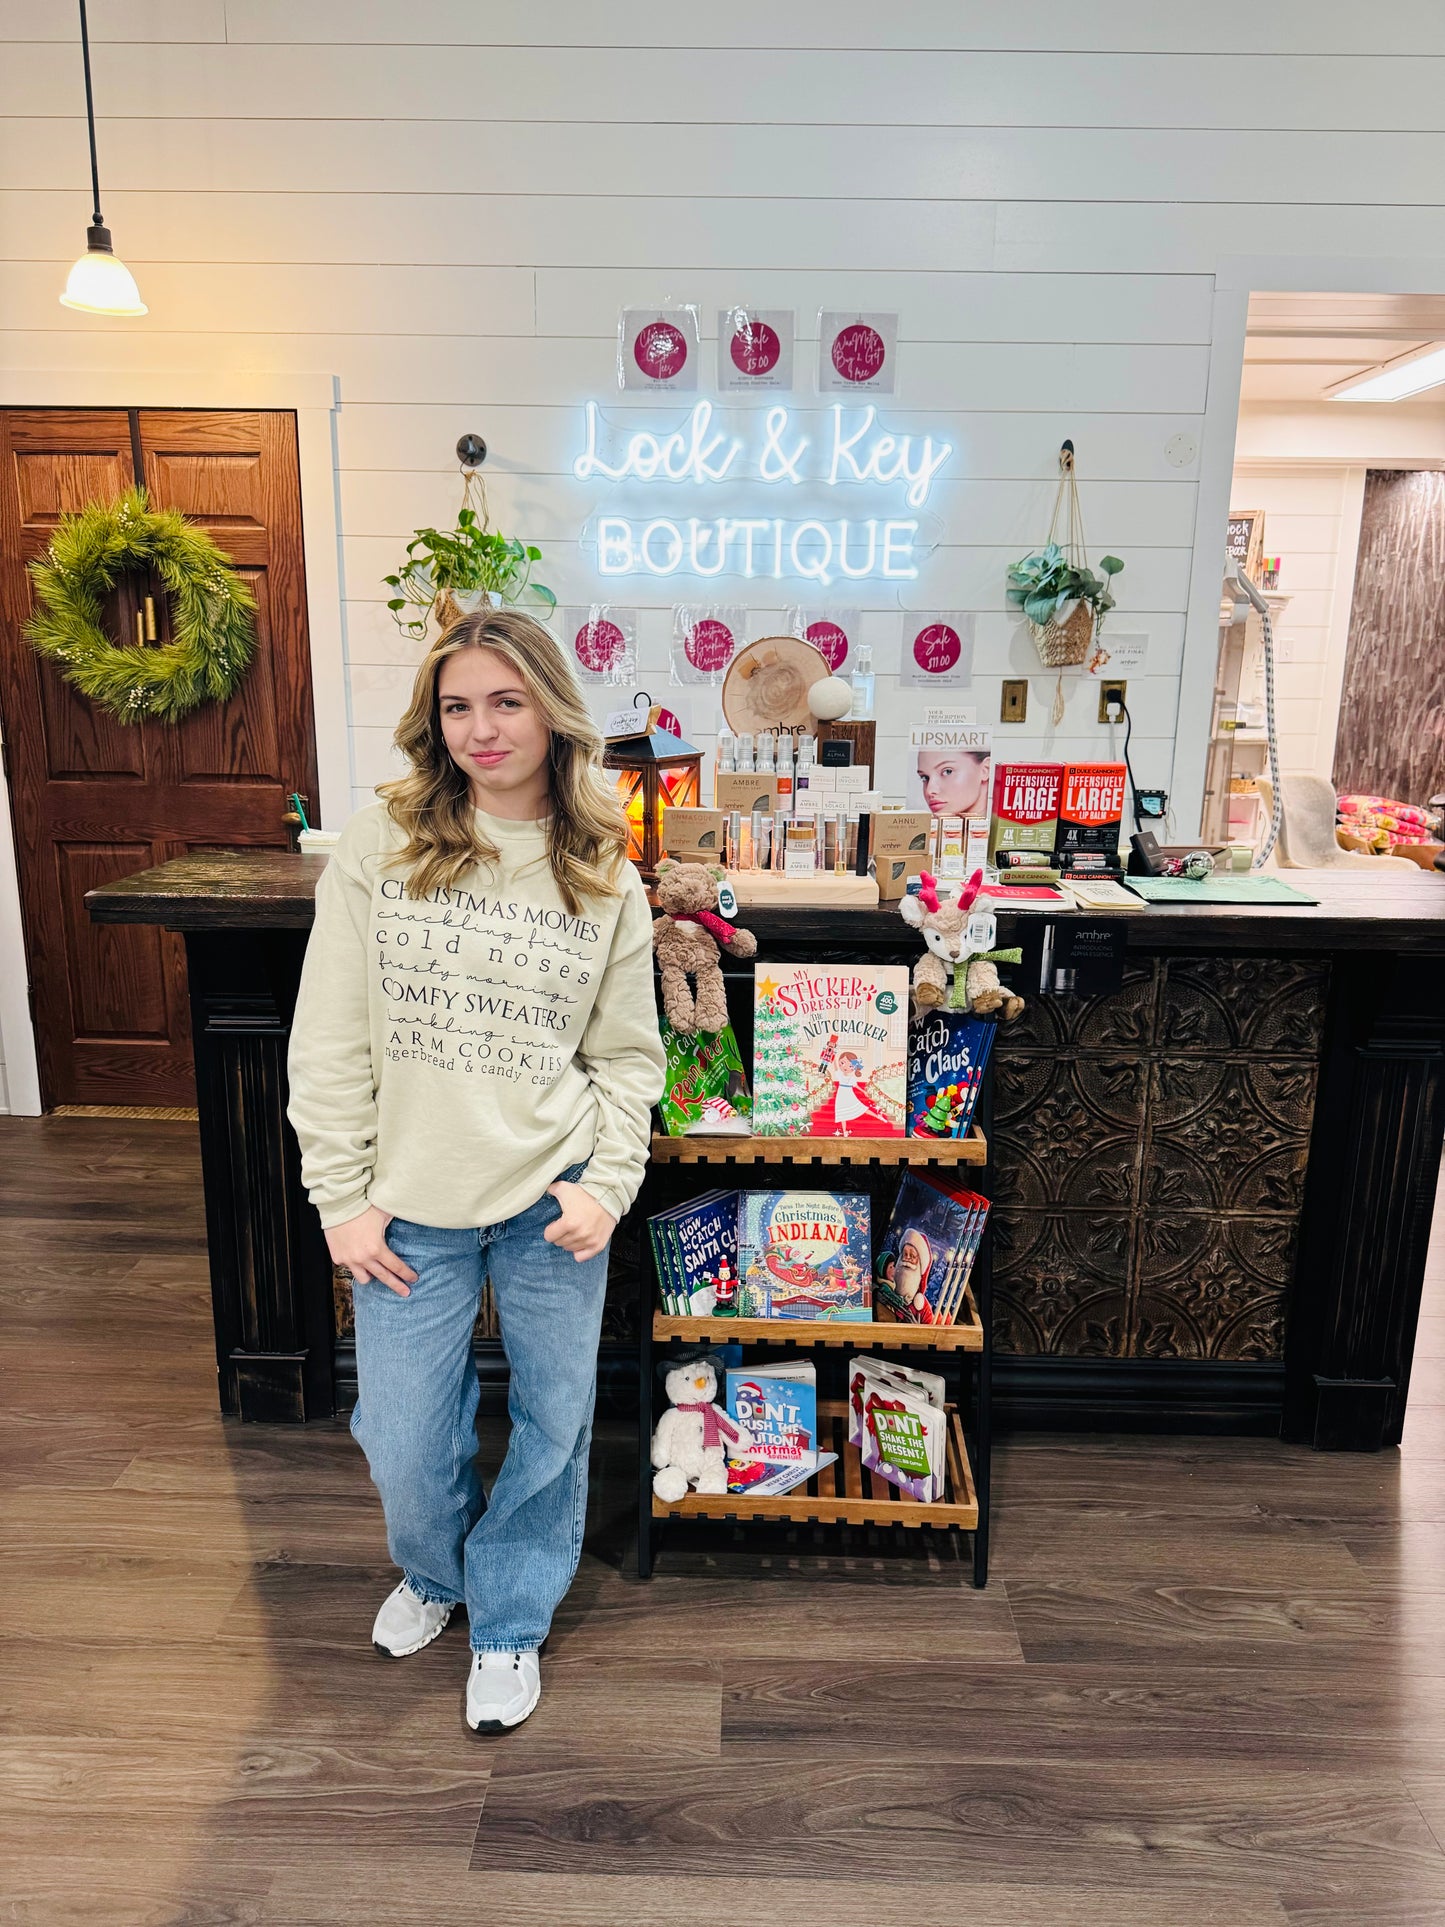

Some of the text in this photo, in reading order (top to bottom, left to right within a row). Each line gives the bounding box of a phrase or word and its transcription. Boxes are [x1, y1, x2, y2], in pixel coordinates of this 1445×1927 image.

[574, 400, 954, 508] Lock & Key
[1227, 520, 1249, 536] ock
[599, 517, 920, 585] BOUTIQUE
[922, 626, 952, 656] Sale
[911, 732, 989, 746] LIPSMART
[1005, 775, 1060, 787] OFFENSIVELY
[1068, 775, 1124, 788] OFFENSIVELY
[1002, 787, 1059, 811] LARGE
[1065, 787, 1123, 811] LARGE
[1015, 811, 1043, 819] LIP BALM
[1078, 811, 1107, 820] LIP BALM
[1003, 829, 1014, 840] 4X
[1066, 829, 1078, 841] 4X
[377, 909, 593, 961] crackling fires
[523, 906, 601, 943] MOVIES
[1075, 929, 1112, 940] ambre
[376, 929, 591, 985] cold noses
[378, 951, 579, 1004] frosty mornings
[793, 968, 809, 982] MY
[381, 977, 571, 1032] COMFY SWEATERS
[777, 976, 863, 1017] STICKER
[801, 997, 862, 1014] DRESS-UP
[662, 1027, 677, 1051] ow
[803, 1019, 888, 1042] NUTCRACKER
[389, 1031, 562, 1072] ARM COOKIES
[385, 1045, 456, 1072] ngerbread
[464, 1060, 474, 1073] &
[481, 1063, 522, 1084] candy
[925, 1047, 970, 1084] Claus
[774, 1210, 837, 1223] Christmas
[806, 1202, 820, 1210] Night
[821, 1203, 839, 1211] Before
[679, 1216, 701, 1243] HOW
[683, 1216, 722, 1252] TO CATCH
[767, 1222, 850, 1245] INDIANA
[684, 1225, 739, 1273] SANTA CLA
[735, 1400, 801, 1424] DON'T
[739, 1419, 800, 1435] PUSH THE
[873, 1412, 920, 1437] DON'T
[743, 1444, 803, 1456] hristmas
[752, 1433, 799, 1447] UTTON!
[880, 1431, 924, 1449] SHAKE THE
[881, 1442, 925, 1460] PRESENT!
[783, 1466, 803, 1479] CHRIST
